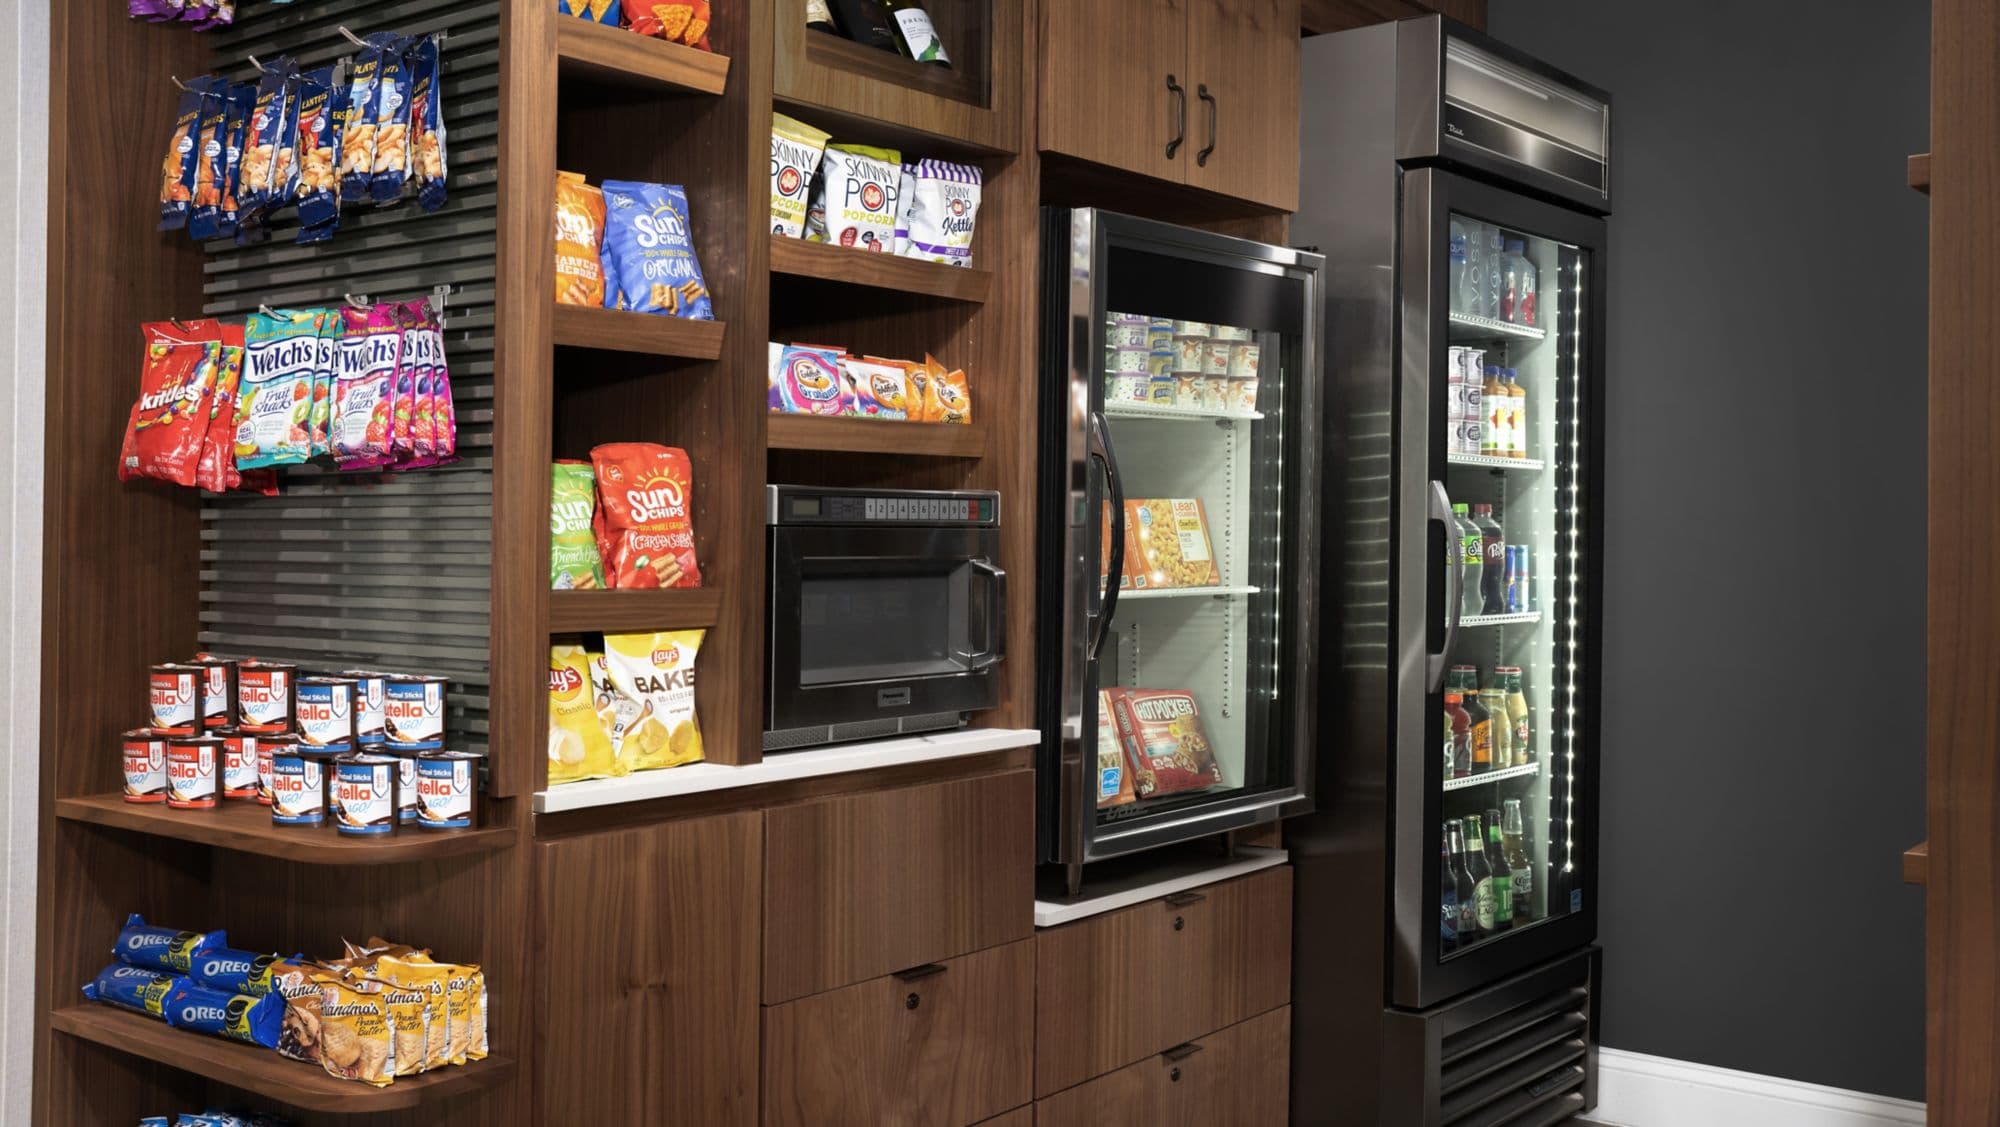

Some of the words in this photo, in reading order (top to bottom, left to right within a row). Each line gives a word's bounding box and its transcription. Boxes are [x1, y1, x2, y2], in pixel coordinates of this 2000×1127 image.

[845, 158, 893, 185] SKINNY
[845, 178, 897, 215] POP
[945, 198, 971, 217] POP
[843, 210, 895, 226] POPCORN
[634, 214, 685, 248] Sun
[659, 233, 689, 247] CHIPS
[1471, 231, 1480, 303] VOSS
[251, 341, 313, 376] Welch's
[343, 339, 397, 373] Wech's
[140, 385, 199, 411] kittles
[265, 386, 291, 401] Fruit
[350, 386, 377, 400] Fruit
[252, 400, 292, 415] Snacks
[627, 488, 684, 523] Sun
[650, 507, 685, 519] CHIPS
[566, 518, 591, 531] CHI
[635, 668, 695, 693] BAKE
[151, 692, 176, 705] tella
[240, 691, 269, 703] tella
[299, 706, 330, 721] tella
[384, 703, 423, 718] utella
[1136, 702, 1157, 720] HOT
[1155, 699, 1194, 719] POCKETS
[124, 759, 148, 773] ella
[169, 765, 196, 778] tella
[273, 776, 303, 792] tella
[339, 786, 371, 801] tella
[129, 934, 173, 950] OREO
[114, 967, 161, 979] OREO
[204, 960, 251, 976] OREO
[384, 991, 424, 1005] dma's
[182, 1006, 226, 1023] OREO
[322, 1002, 380, 1018] andma's
[357, 1026, 386, 1037] Butter
